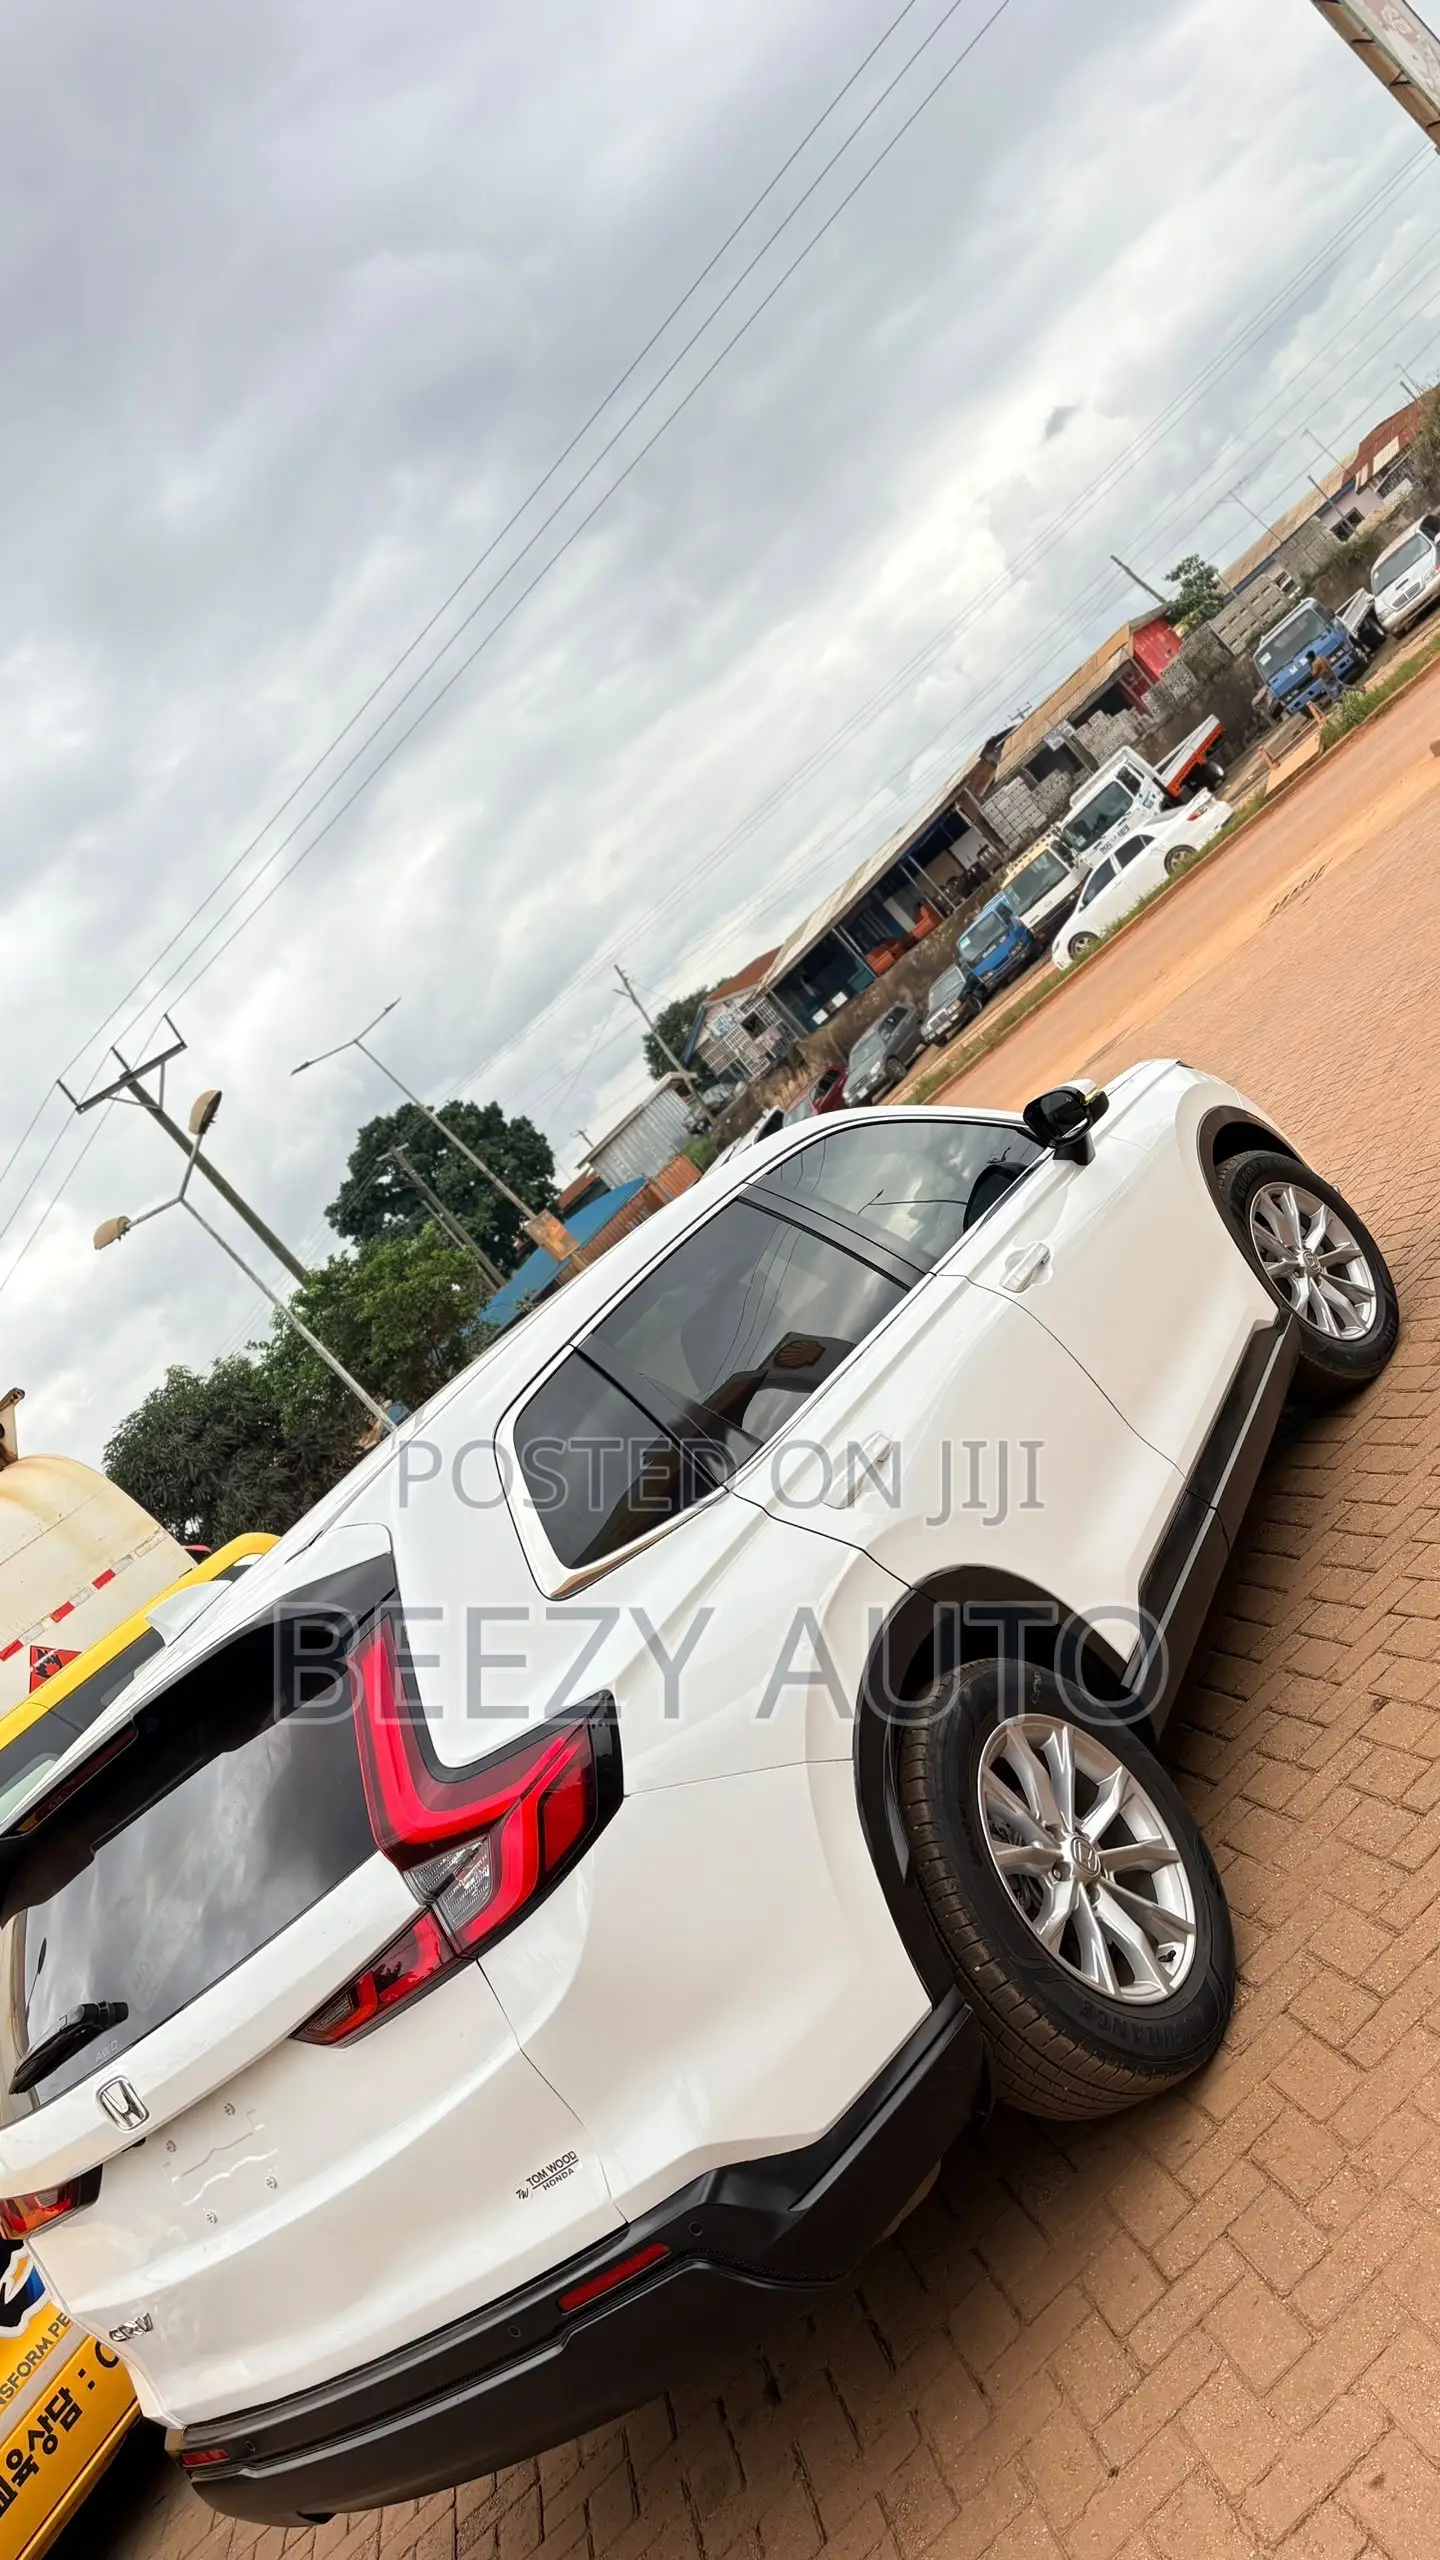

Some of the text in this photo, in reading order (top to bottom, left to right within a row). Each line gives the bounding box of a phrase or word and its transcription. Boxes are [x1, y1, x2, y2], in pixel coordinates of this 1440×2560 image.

[526, 2150, 578, 2187] TOM WOOD
[542, 2168, 575, 2191] HONDA
